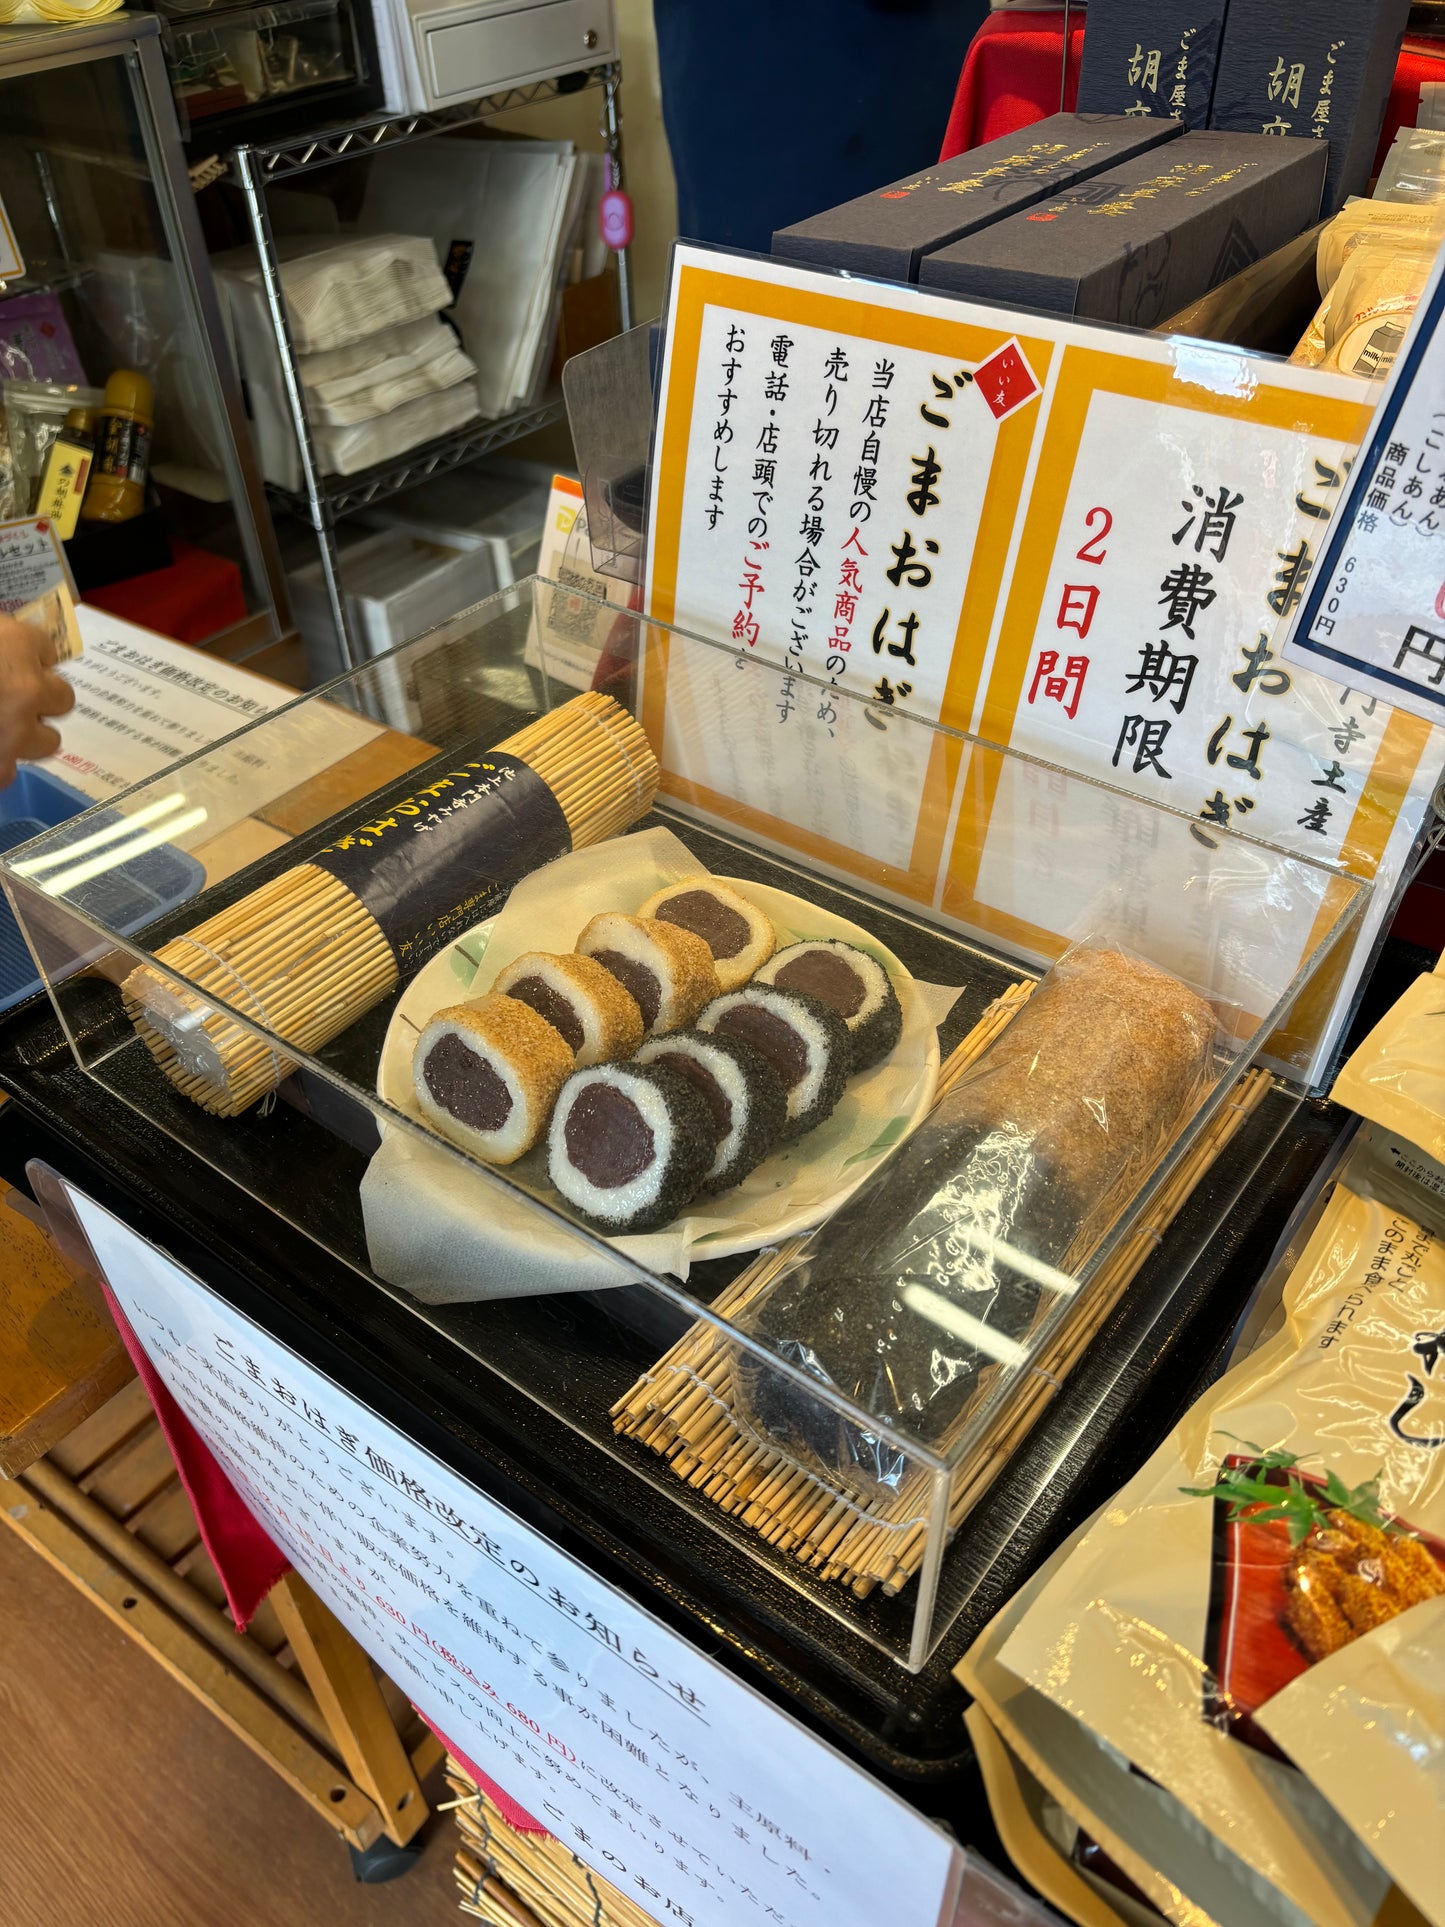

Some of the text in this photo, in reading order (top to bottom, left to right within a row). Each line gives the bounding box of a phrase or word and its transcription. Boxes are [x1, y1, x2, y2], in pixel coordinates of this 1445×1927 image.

[704, 322, 746, 532] おすすめします
[992, 358, 1021, 408] いい友
[1363, 348, 1380, 362] milk
[775, 345, 849, 725] 売り切れる場合がございます
[862, 369, 974, 733] ごまおはぎ
[1027, 506, 1114, 721] 2日間
[1111, 484, 1244, 781] 消費期限
[1314, 441, 1411, 638] 商品価格 630円
[99, 640, 275, 717] ごまおはぎ価格改定のお知ら
[1190, 456, 1358, 850] ごまおはぎ
[412, 766, 517, 833] 池上本門寺みやげ
[1317, 1216, 1410, 1350] このまま食べられます
[131, 1299, 456, 1559] いつもご来店ありがとうございます。
[212, 1333, 708, 1711] ごまおはぎ価格改定のお知らせ
[542, 1798, 696, 1927] ごまのお店
